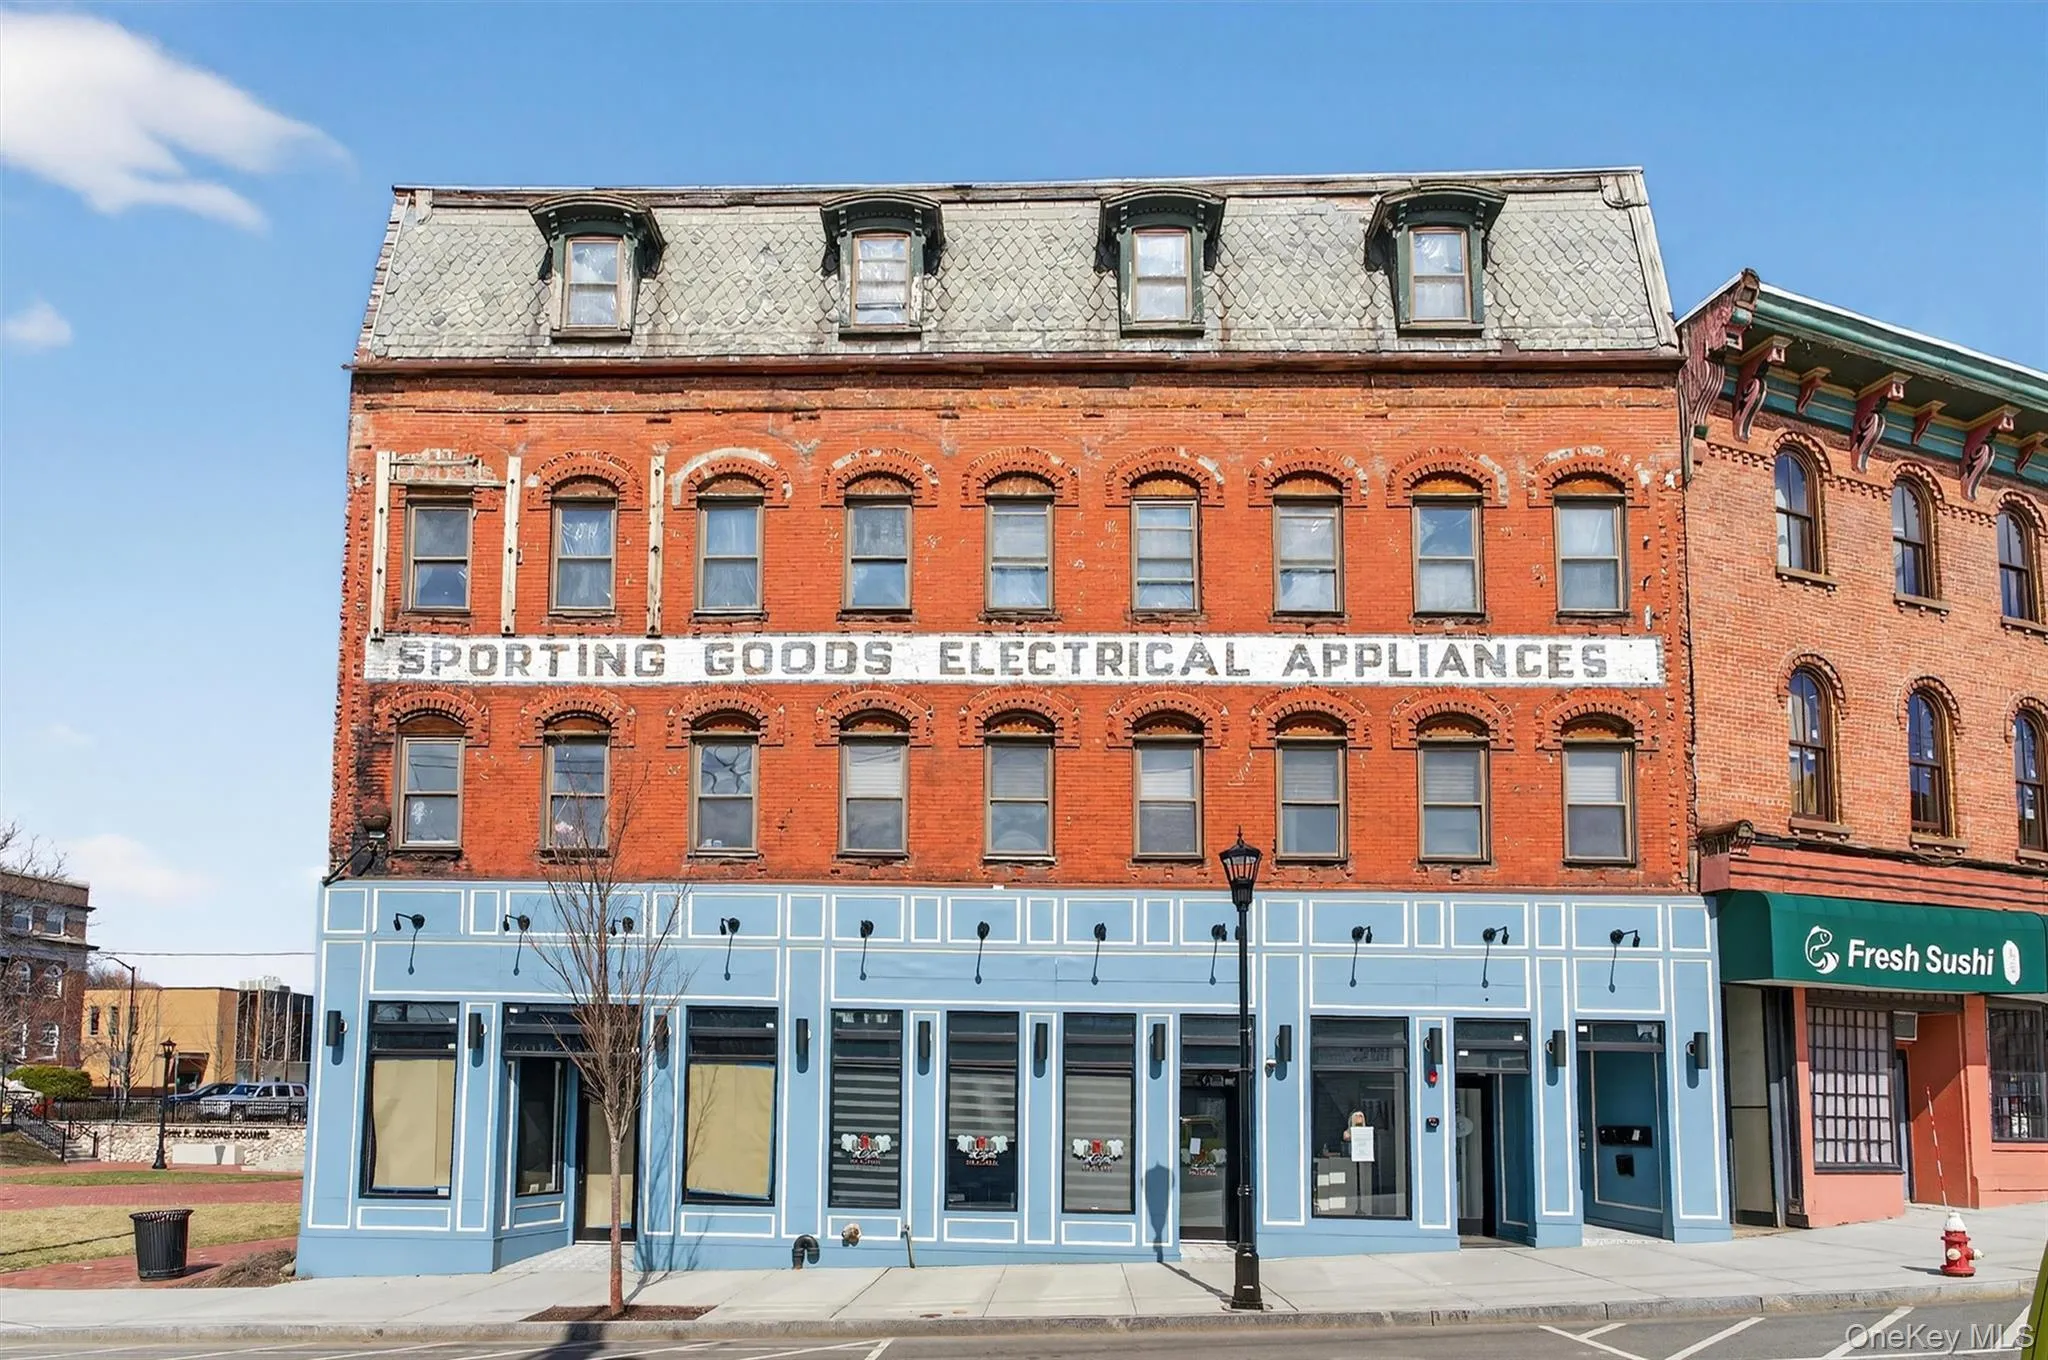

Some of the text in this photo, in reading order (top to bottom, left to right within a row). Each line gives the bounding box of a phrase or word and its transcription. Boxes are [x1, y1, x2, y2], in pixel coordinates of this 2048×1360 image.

[398, 640, 1608, 679] SPORTING GOODS ELECTRICAL APPLIANCES
[1847, 938, 1920, 973] Fresh
[1925, 944, 1994, 976] Sushi
